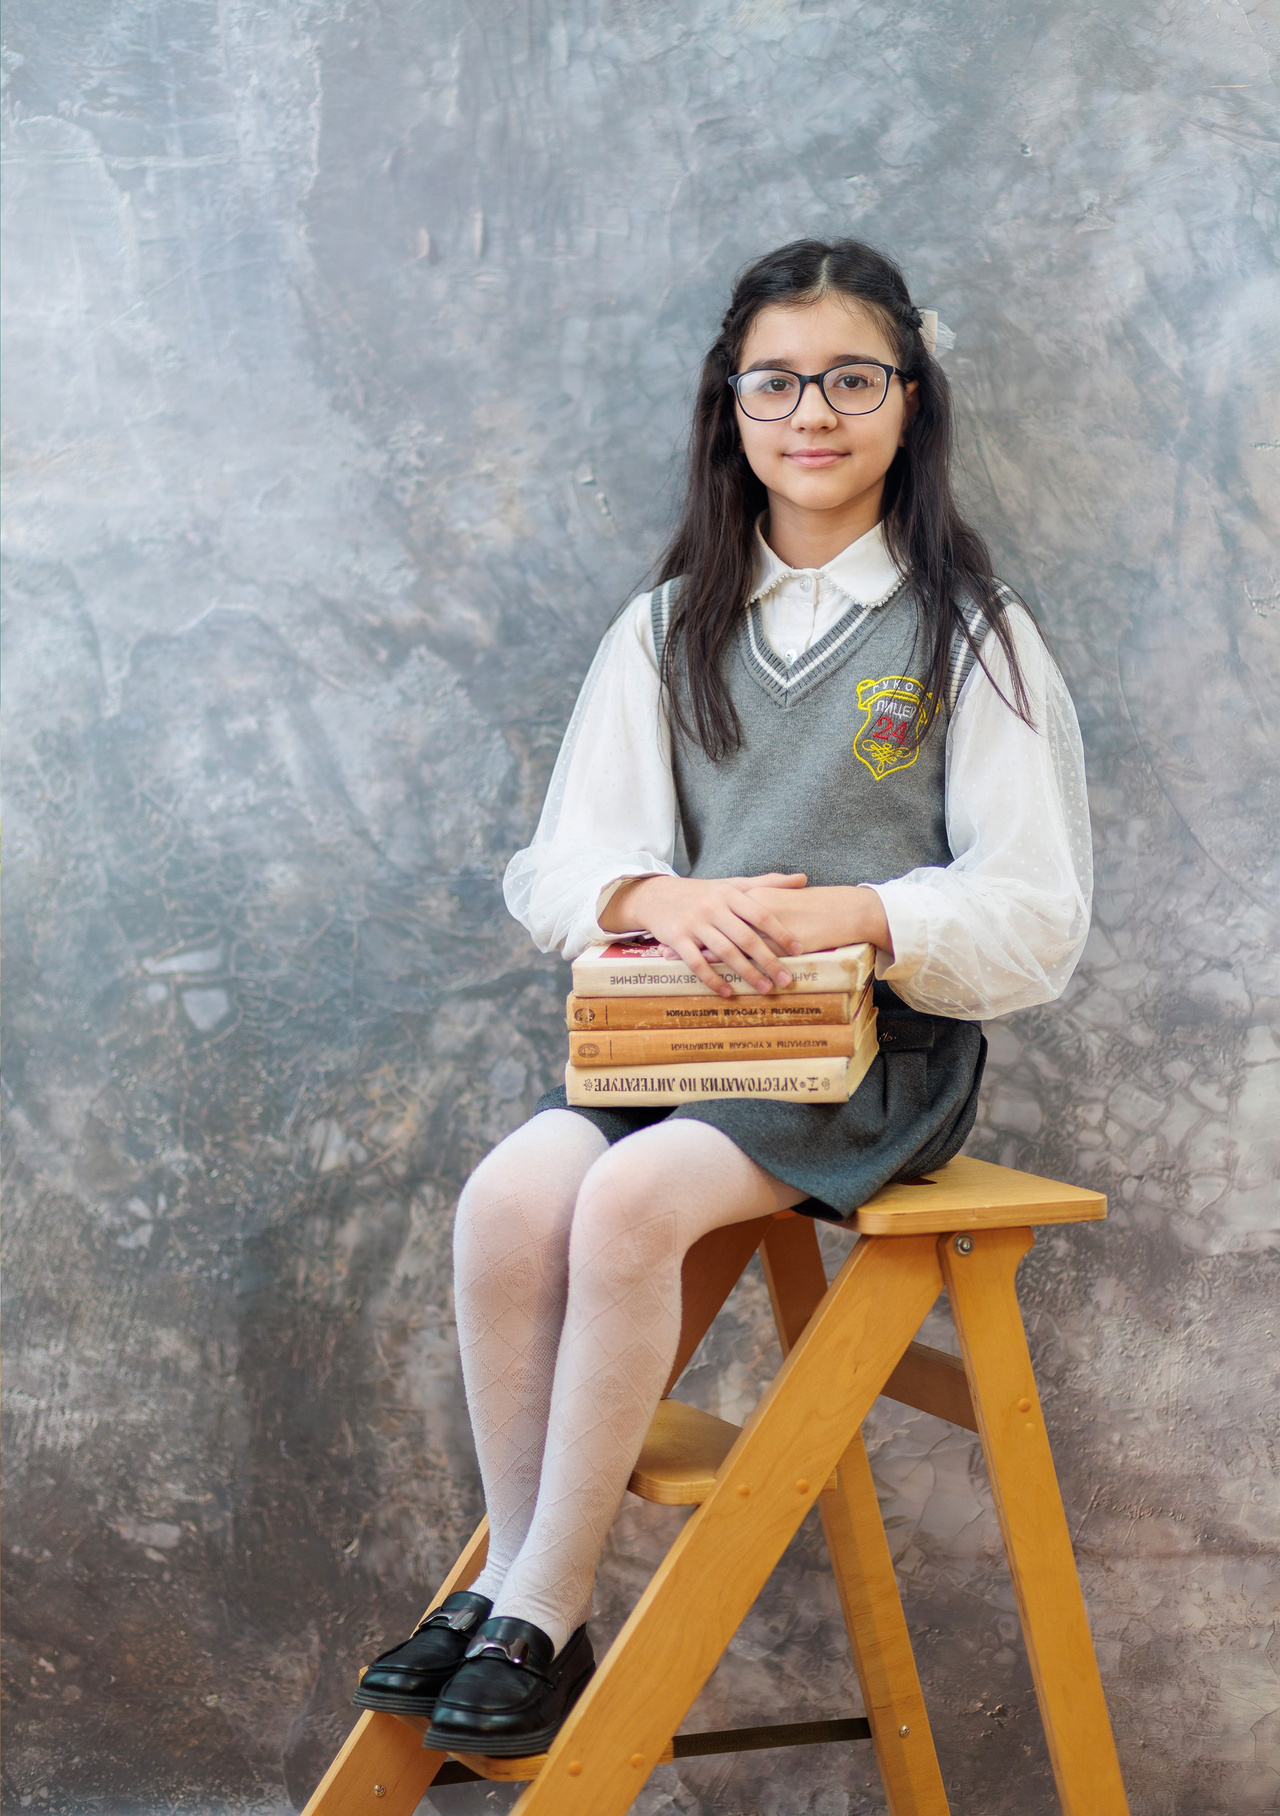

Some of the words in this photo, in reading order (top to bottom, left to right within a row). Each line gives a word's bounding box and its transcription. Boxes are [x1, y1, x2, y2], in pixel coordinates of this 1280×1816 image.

[872, 715, 910, 745] 24
[666, 1009, 719, 1017] МАТЕМАТИКИ
[723, 1008, 759, 1016] УРОКАМ
[770, 1007, 822, 1015] МАТЕРИАЛЫ
[671, 1042, 724, 1051] МАТЕМАТИКИ
[729, 1041, 764, 1049] УРОКАМ
[776, 1039, 828, 1048] МАТЕРИАЛЫ
[594, 1077, 675, 1092] ЛИТЕРАТУРЕ
[679, 1077, 697, 1092] ПО
[701, 1077, 799, 1092] ХРЕСТОМАТИЯ
